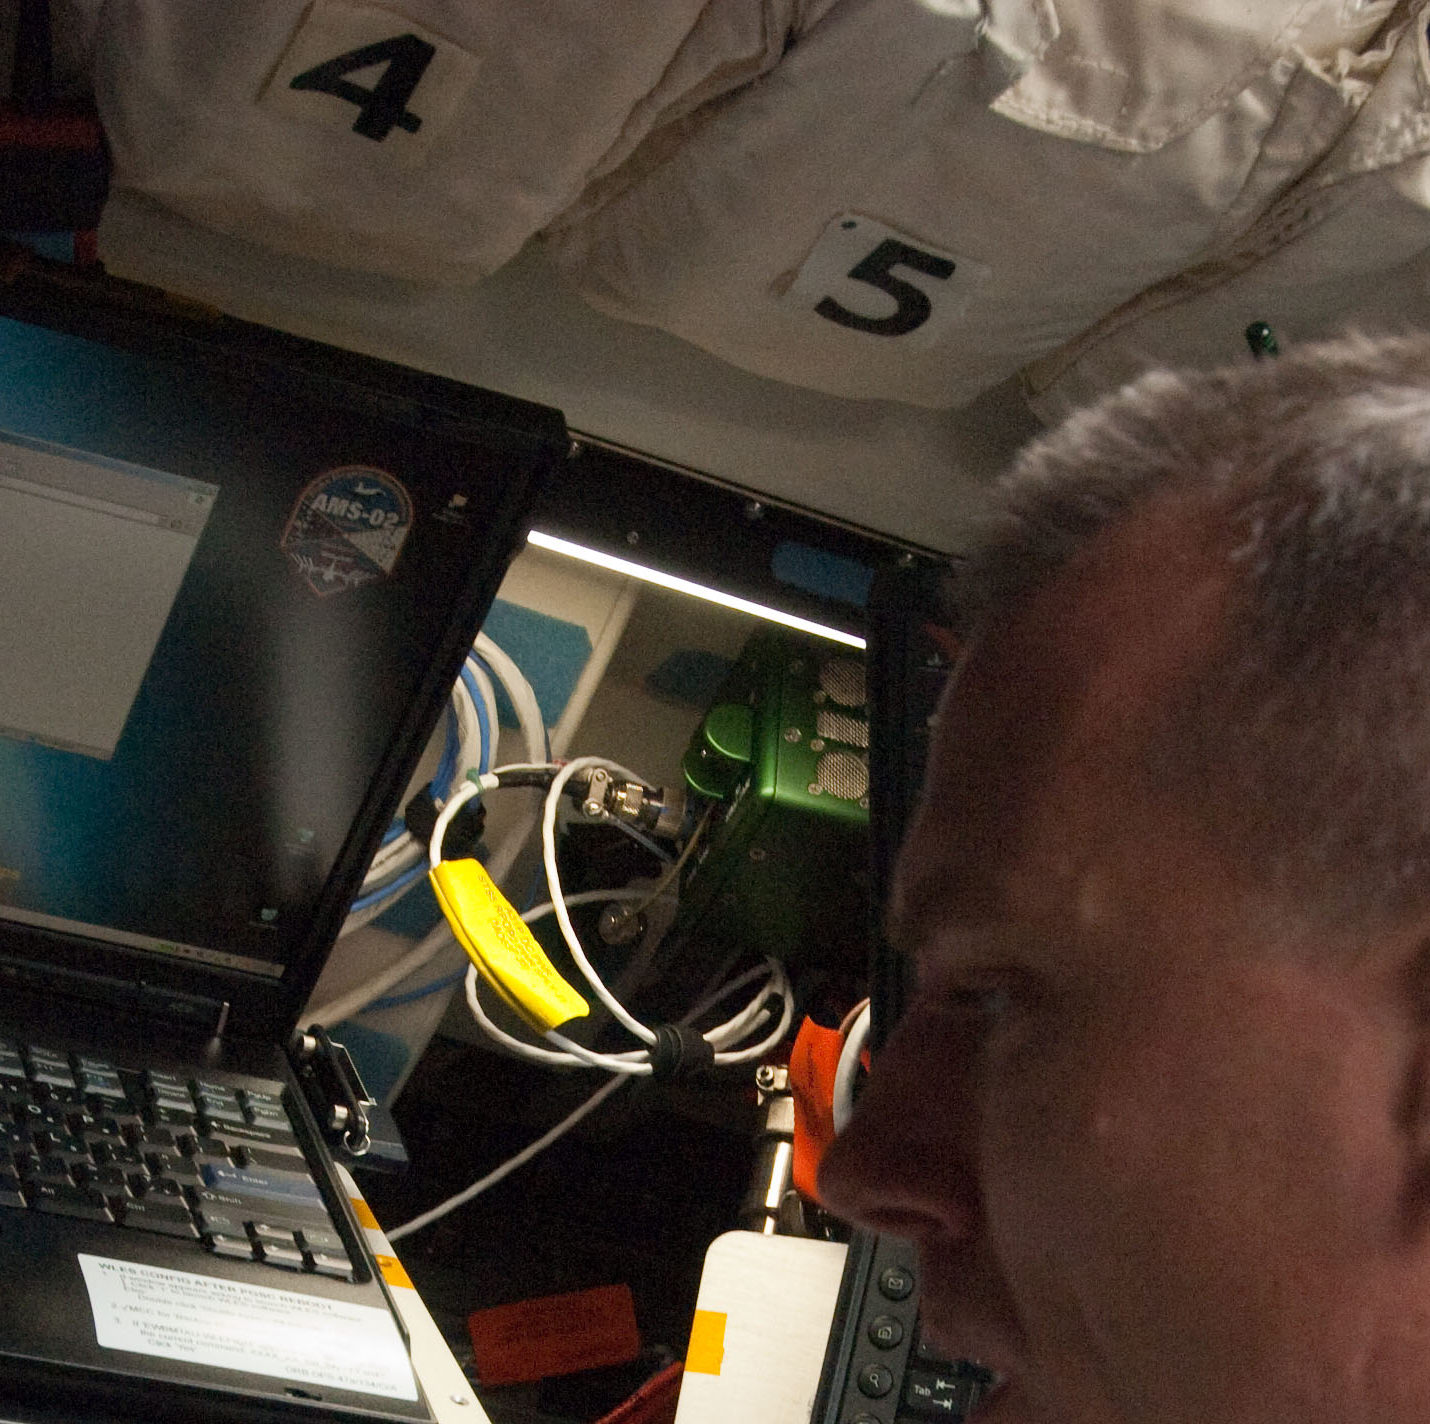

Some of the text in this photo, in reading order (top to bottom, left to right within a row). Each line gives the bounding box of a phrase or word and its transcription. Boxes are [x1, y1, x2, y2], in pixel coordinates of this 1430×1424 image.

[289, 33, 438, 143] 4
[813, 237, 956, 337] 5
[310, 490, 400, 531] AMS-02
[98, 1261, 137, 1275] WLES
[139, 1269, 191, 1285] CONFIG
[193, 1279, 236, 1293] AFTER
[279, 1295, 332, 1311] REBOOT
[913, 1383, 932, 1398] Tab
